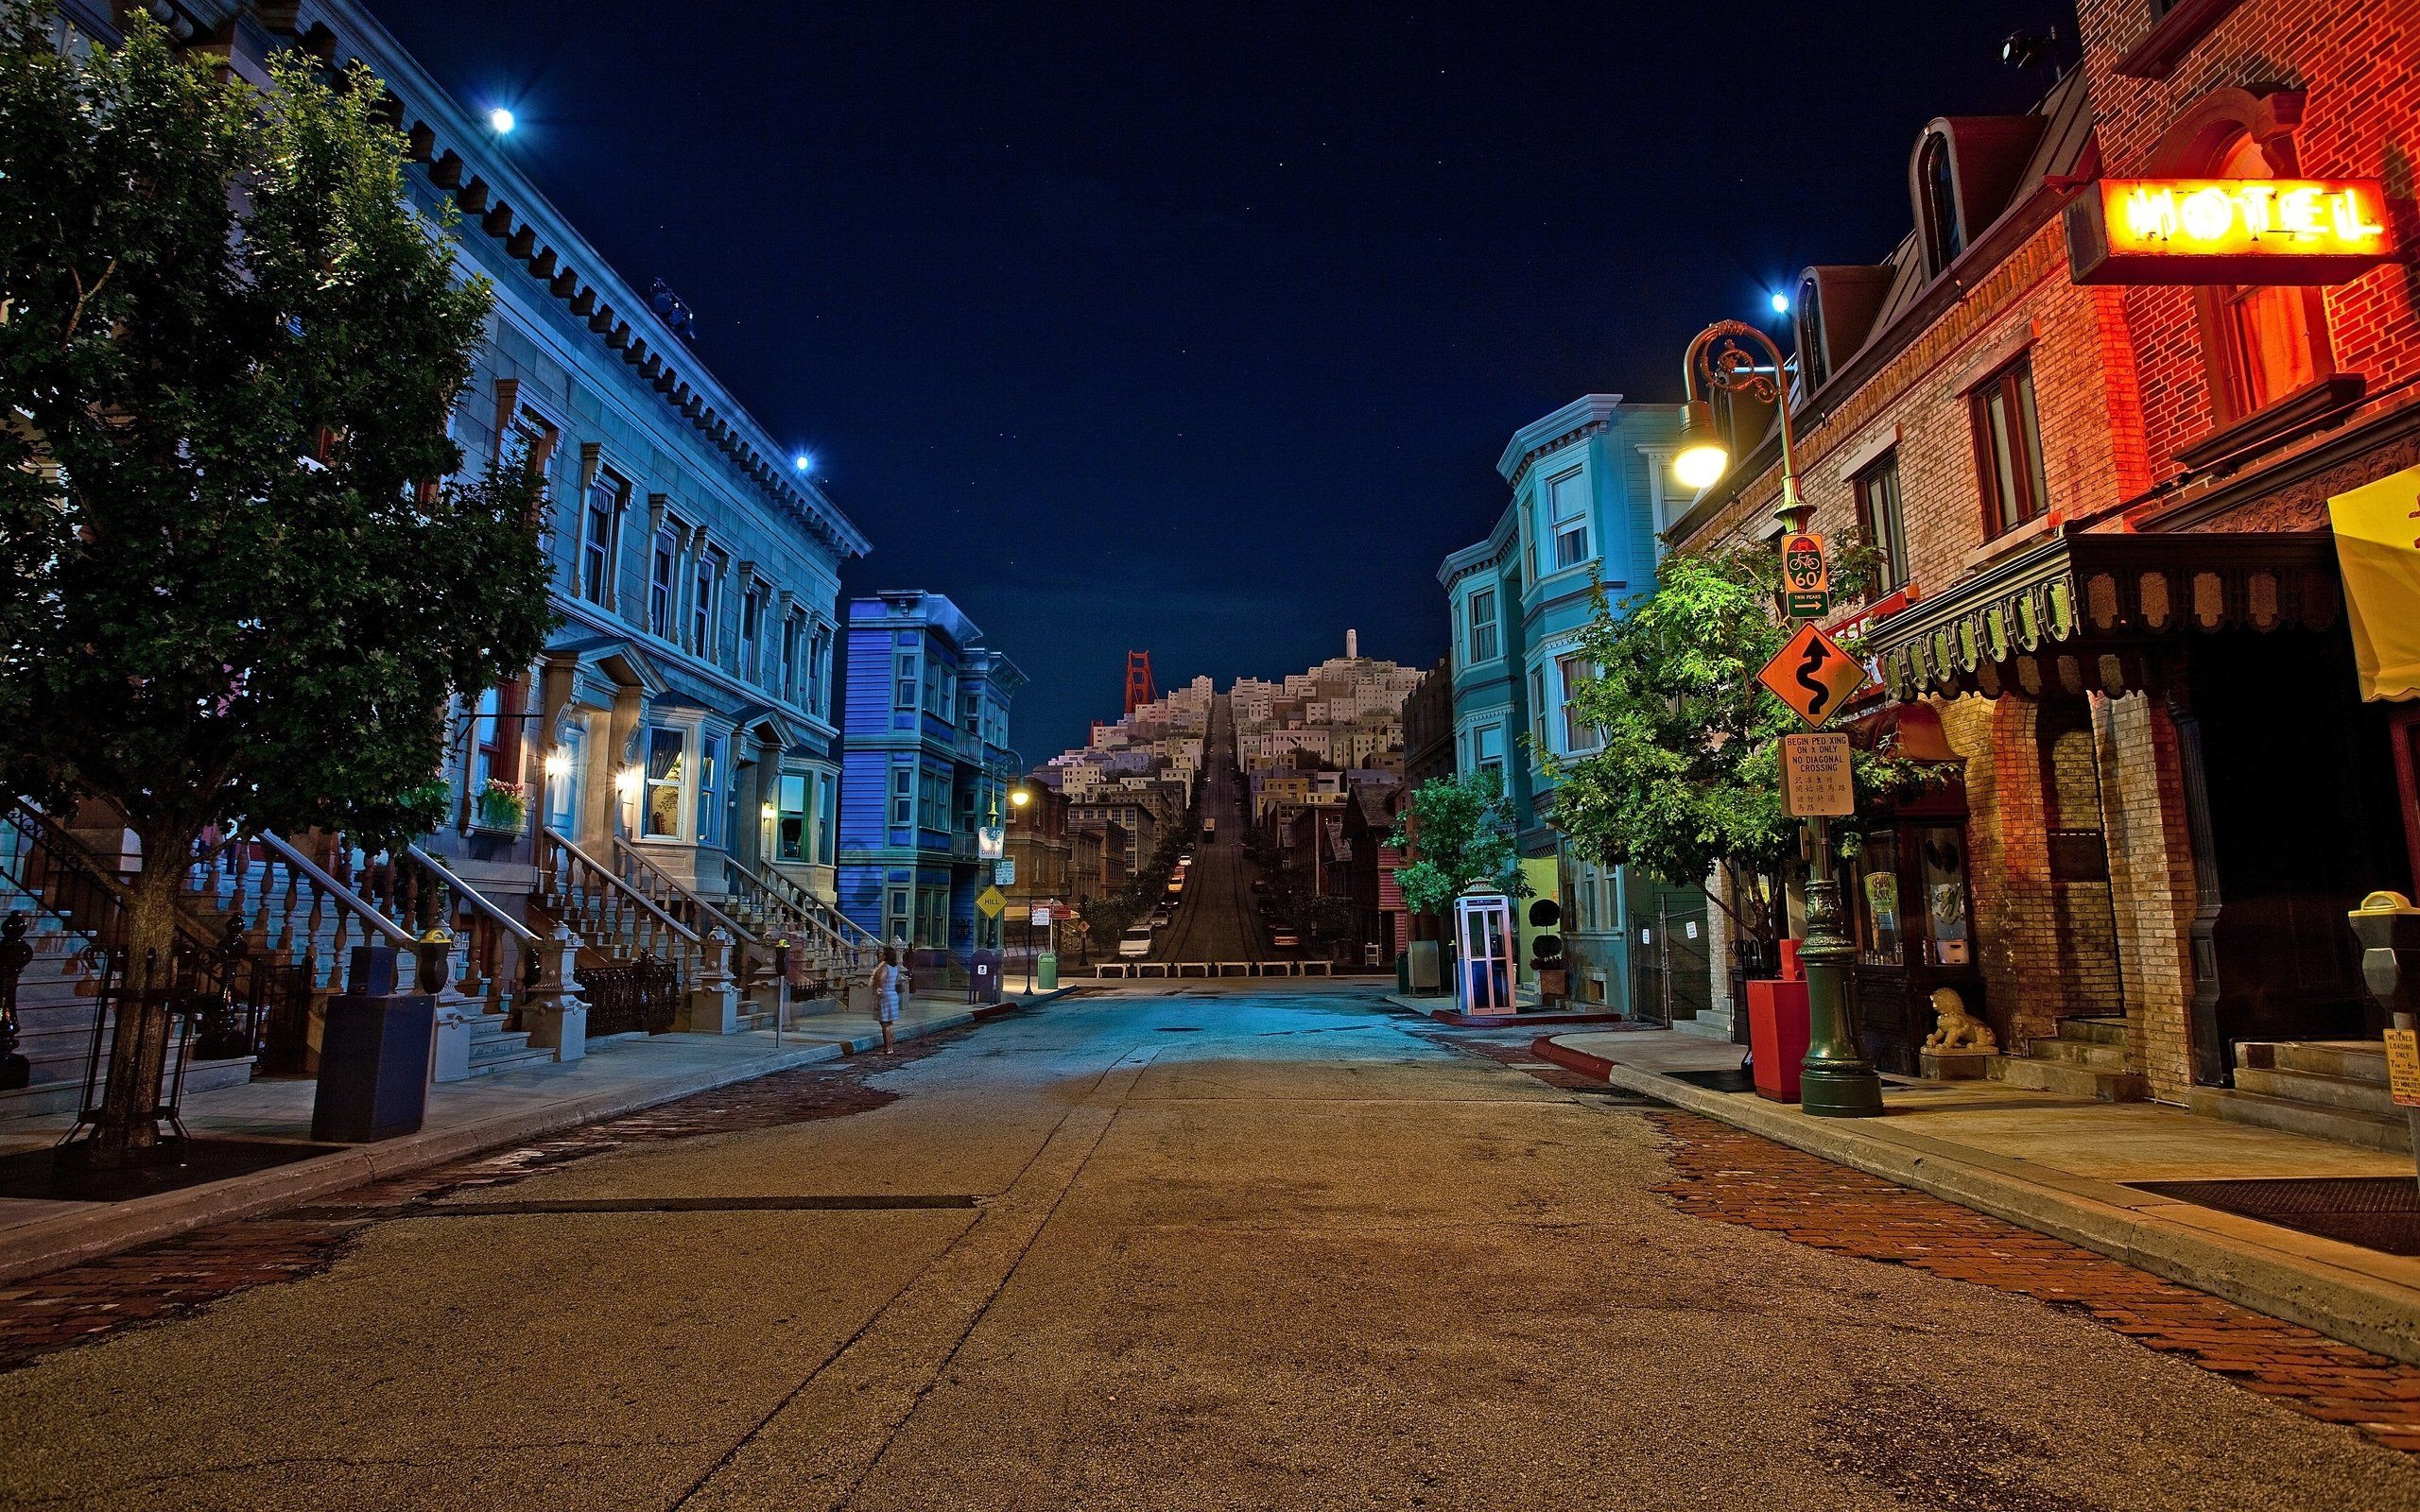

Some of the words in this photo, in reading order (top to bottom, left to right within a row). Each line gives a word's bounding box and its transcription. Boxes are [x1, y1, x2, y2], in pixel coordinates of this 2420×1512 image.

[2127, 186, 2382, 241] MOTEL
[1795, 571, 1817, 587] 60
[1829, 736, 1846, 745] XING
[1797, 746, 1807, 754] ON
[1792, 756, 1803, 765] NO
[1806, 755, 1843, 764] DIAGONAL
[1800, 764, 1838, 772] CROSSING
[991, 830, 1002, 839] 49
